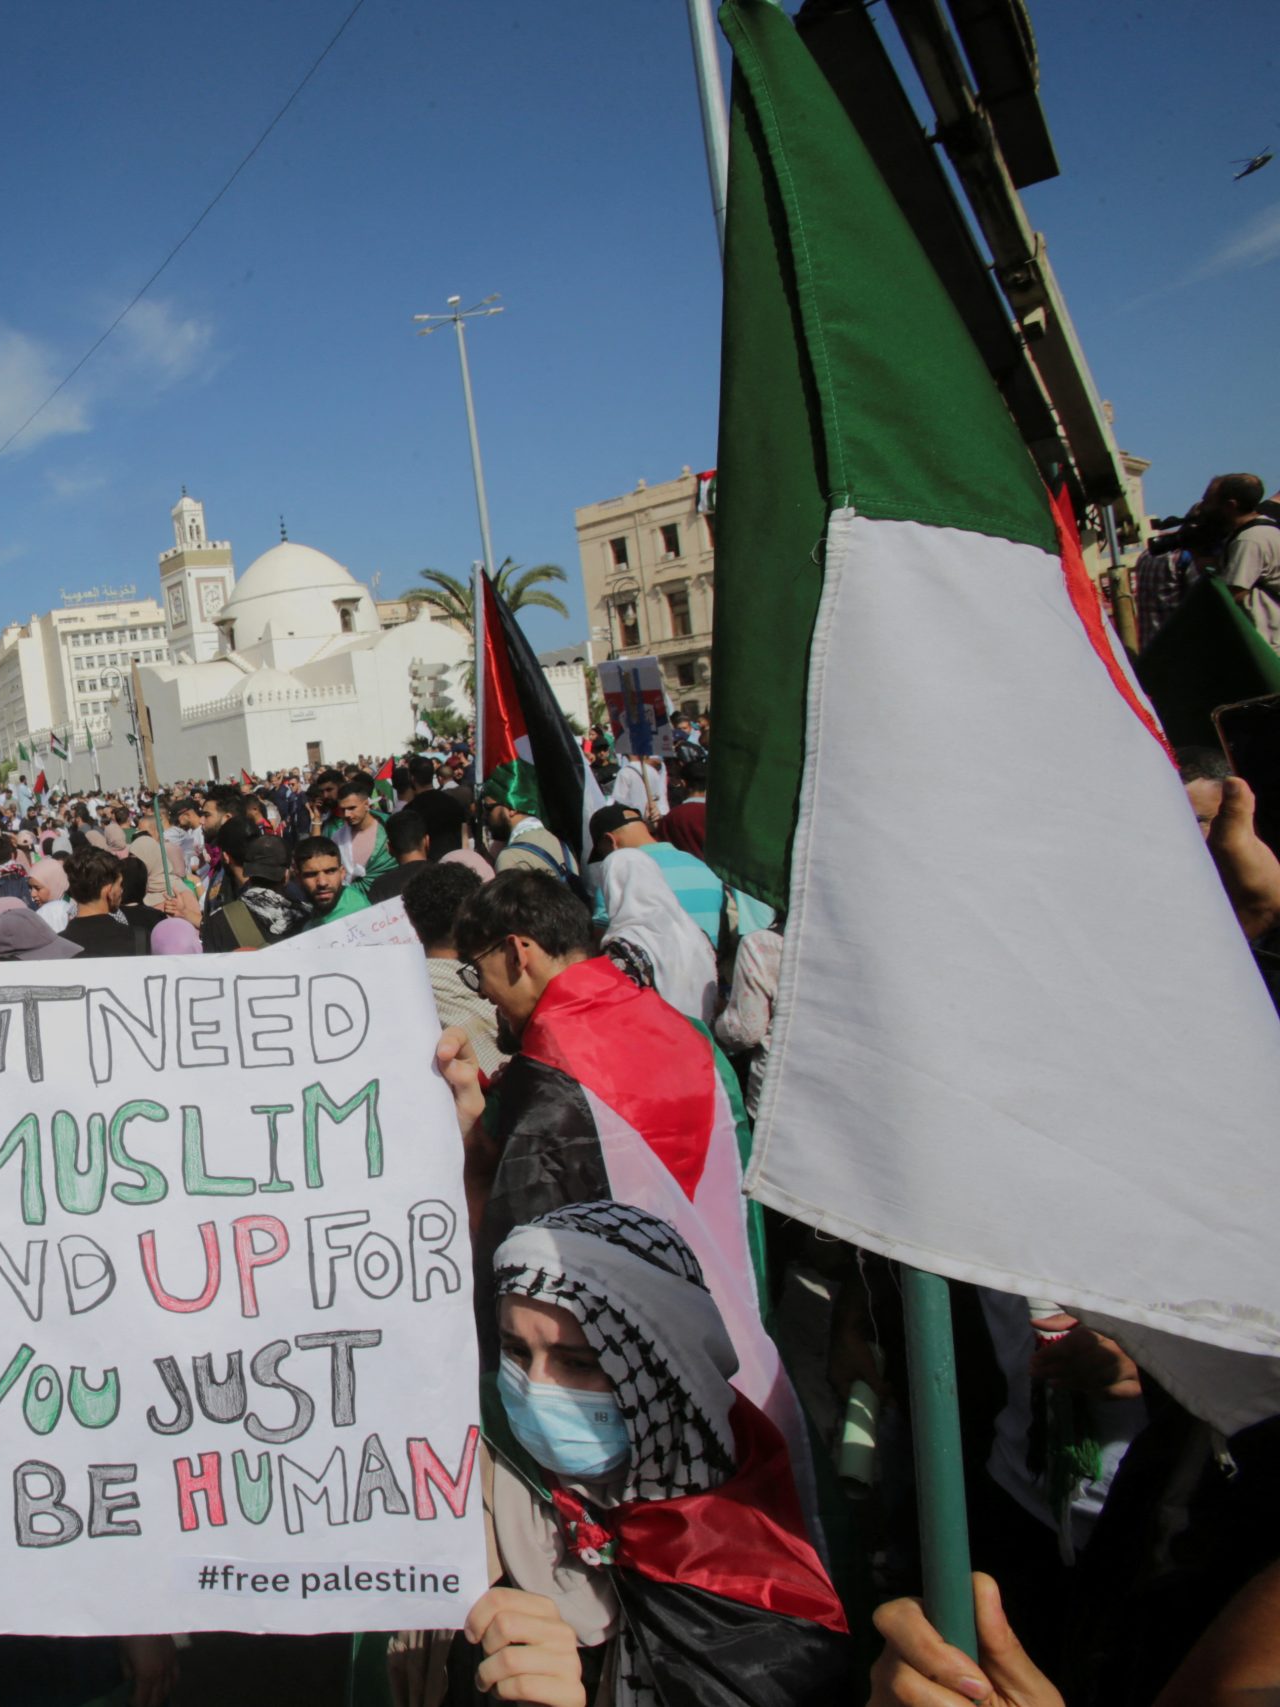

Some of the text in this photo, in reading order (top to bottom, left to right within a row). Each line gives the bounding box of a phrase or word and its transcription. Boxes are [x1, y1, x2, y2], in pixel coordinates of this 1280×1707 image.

[86, 973, 369, 1087] NEED
[138, 1214, 290, 1318] UP
[305, 1199, 461, 1309] FOR
[146, 1329, 382, 1444] JUST
[13, 1461, 141, 1547] BE
[173, 1425, 480, 1535] HUMAN
[198, 1564, 460, 1599] #free palestine
